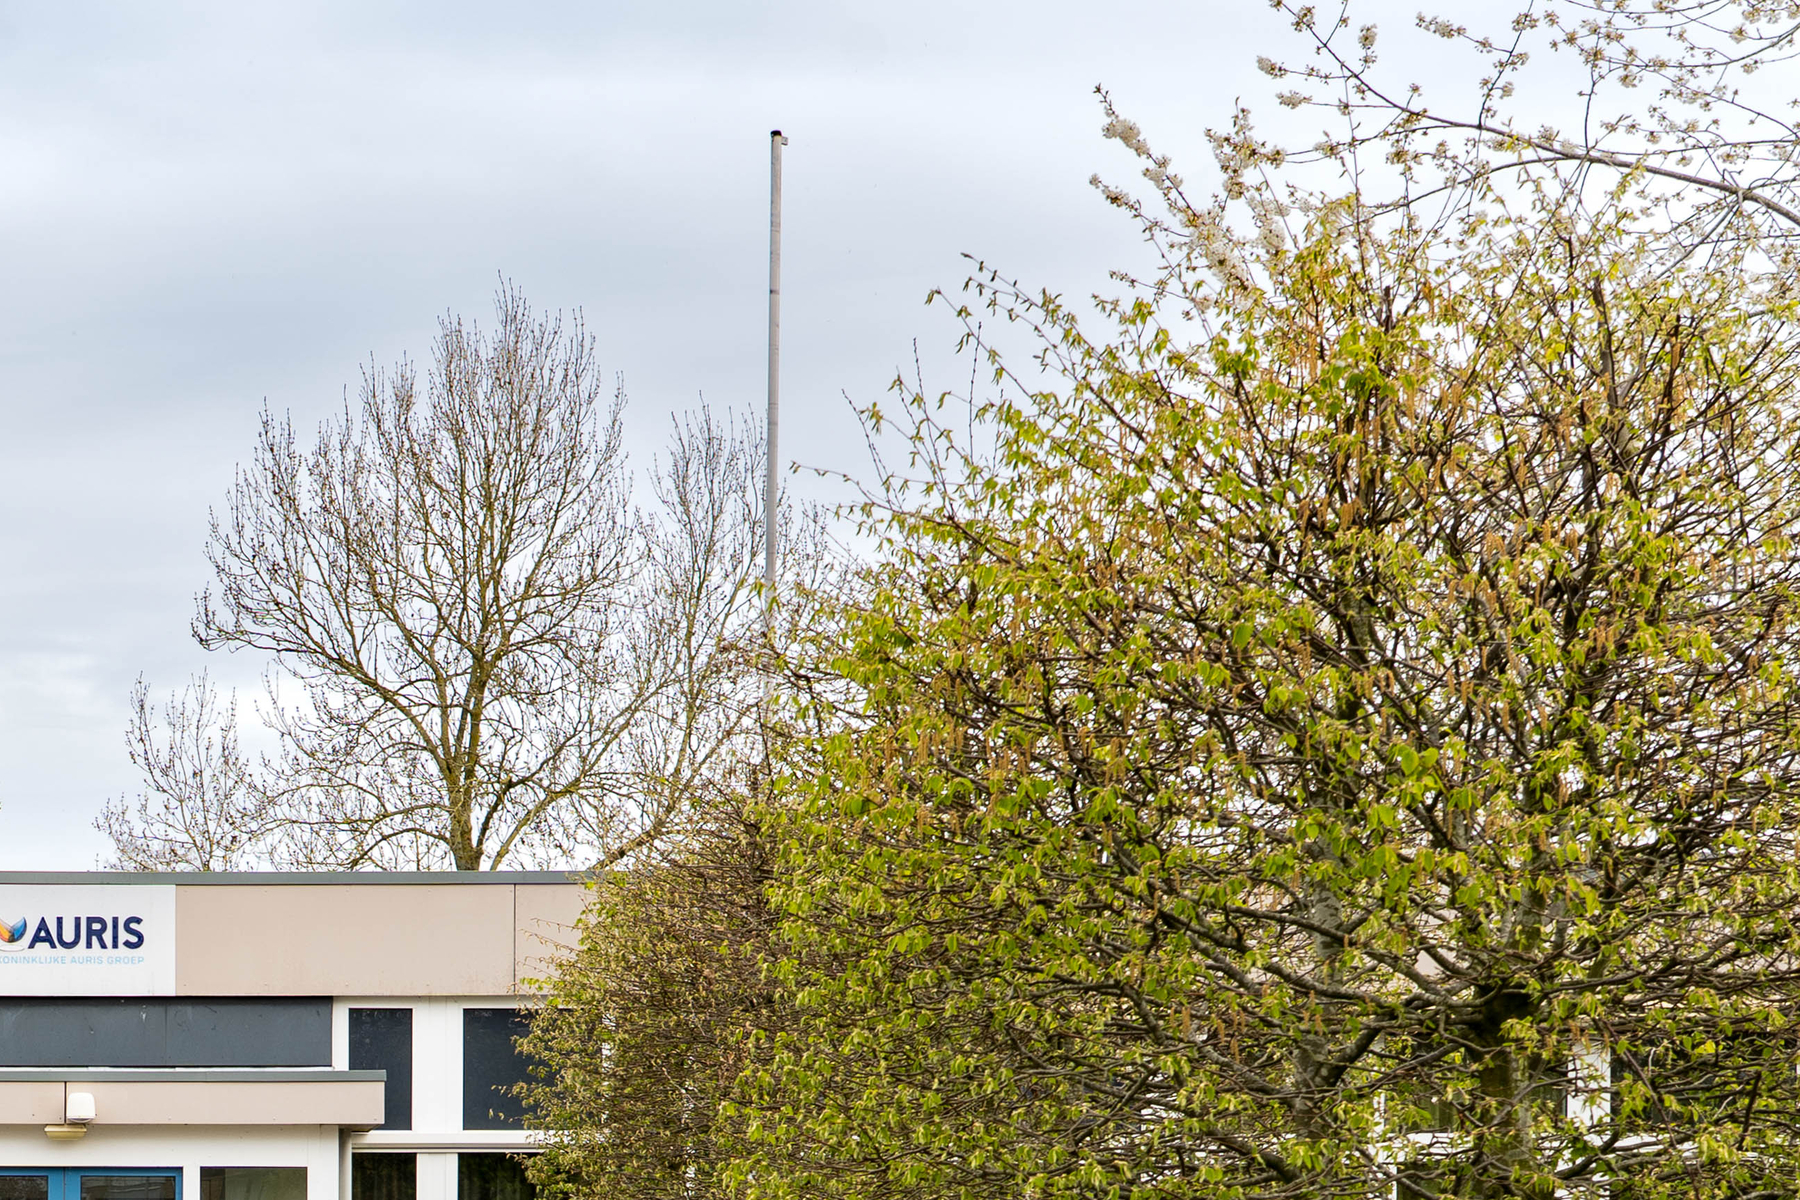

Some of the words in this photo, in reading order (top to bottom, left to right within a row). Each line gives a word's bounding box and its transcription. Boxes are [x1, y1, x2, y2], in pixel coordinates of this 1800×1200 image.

[27, 916, 145, 949] AURIS
[70, 956, 104, 965] AURIS
[107, 956, 145, 965] GROEP
